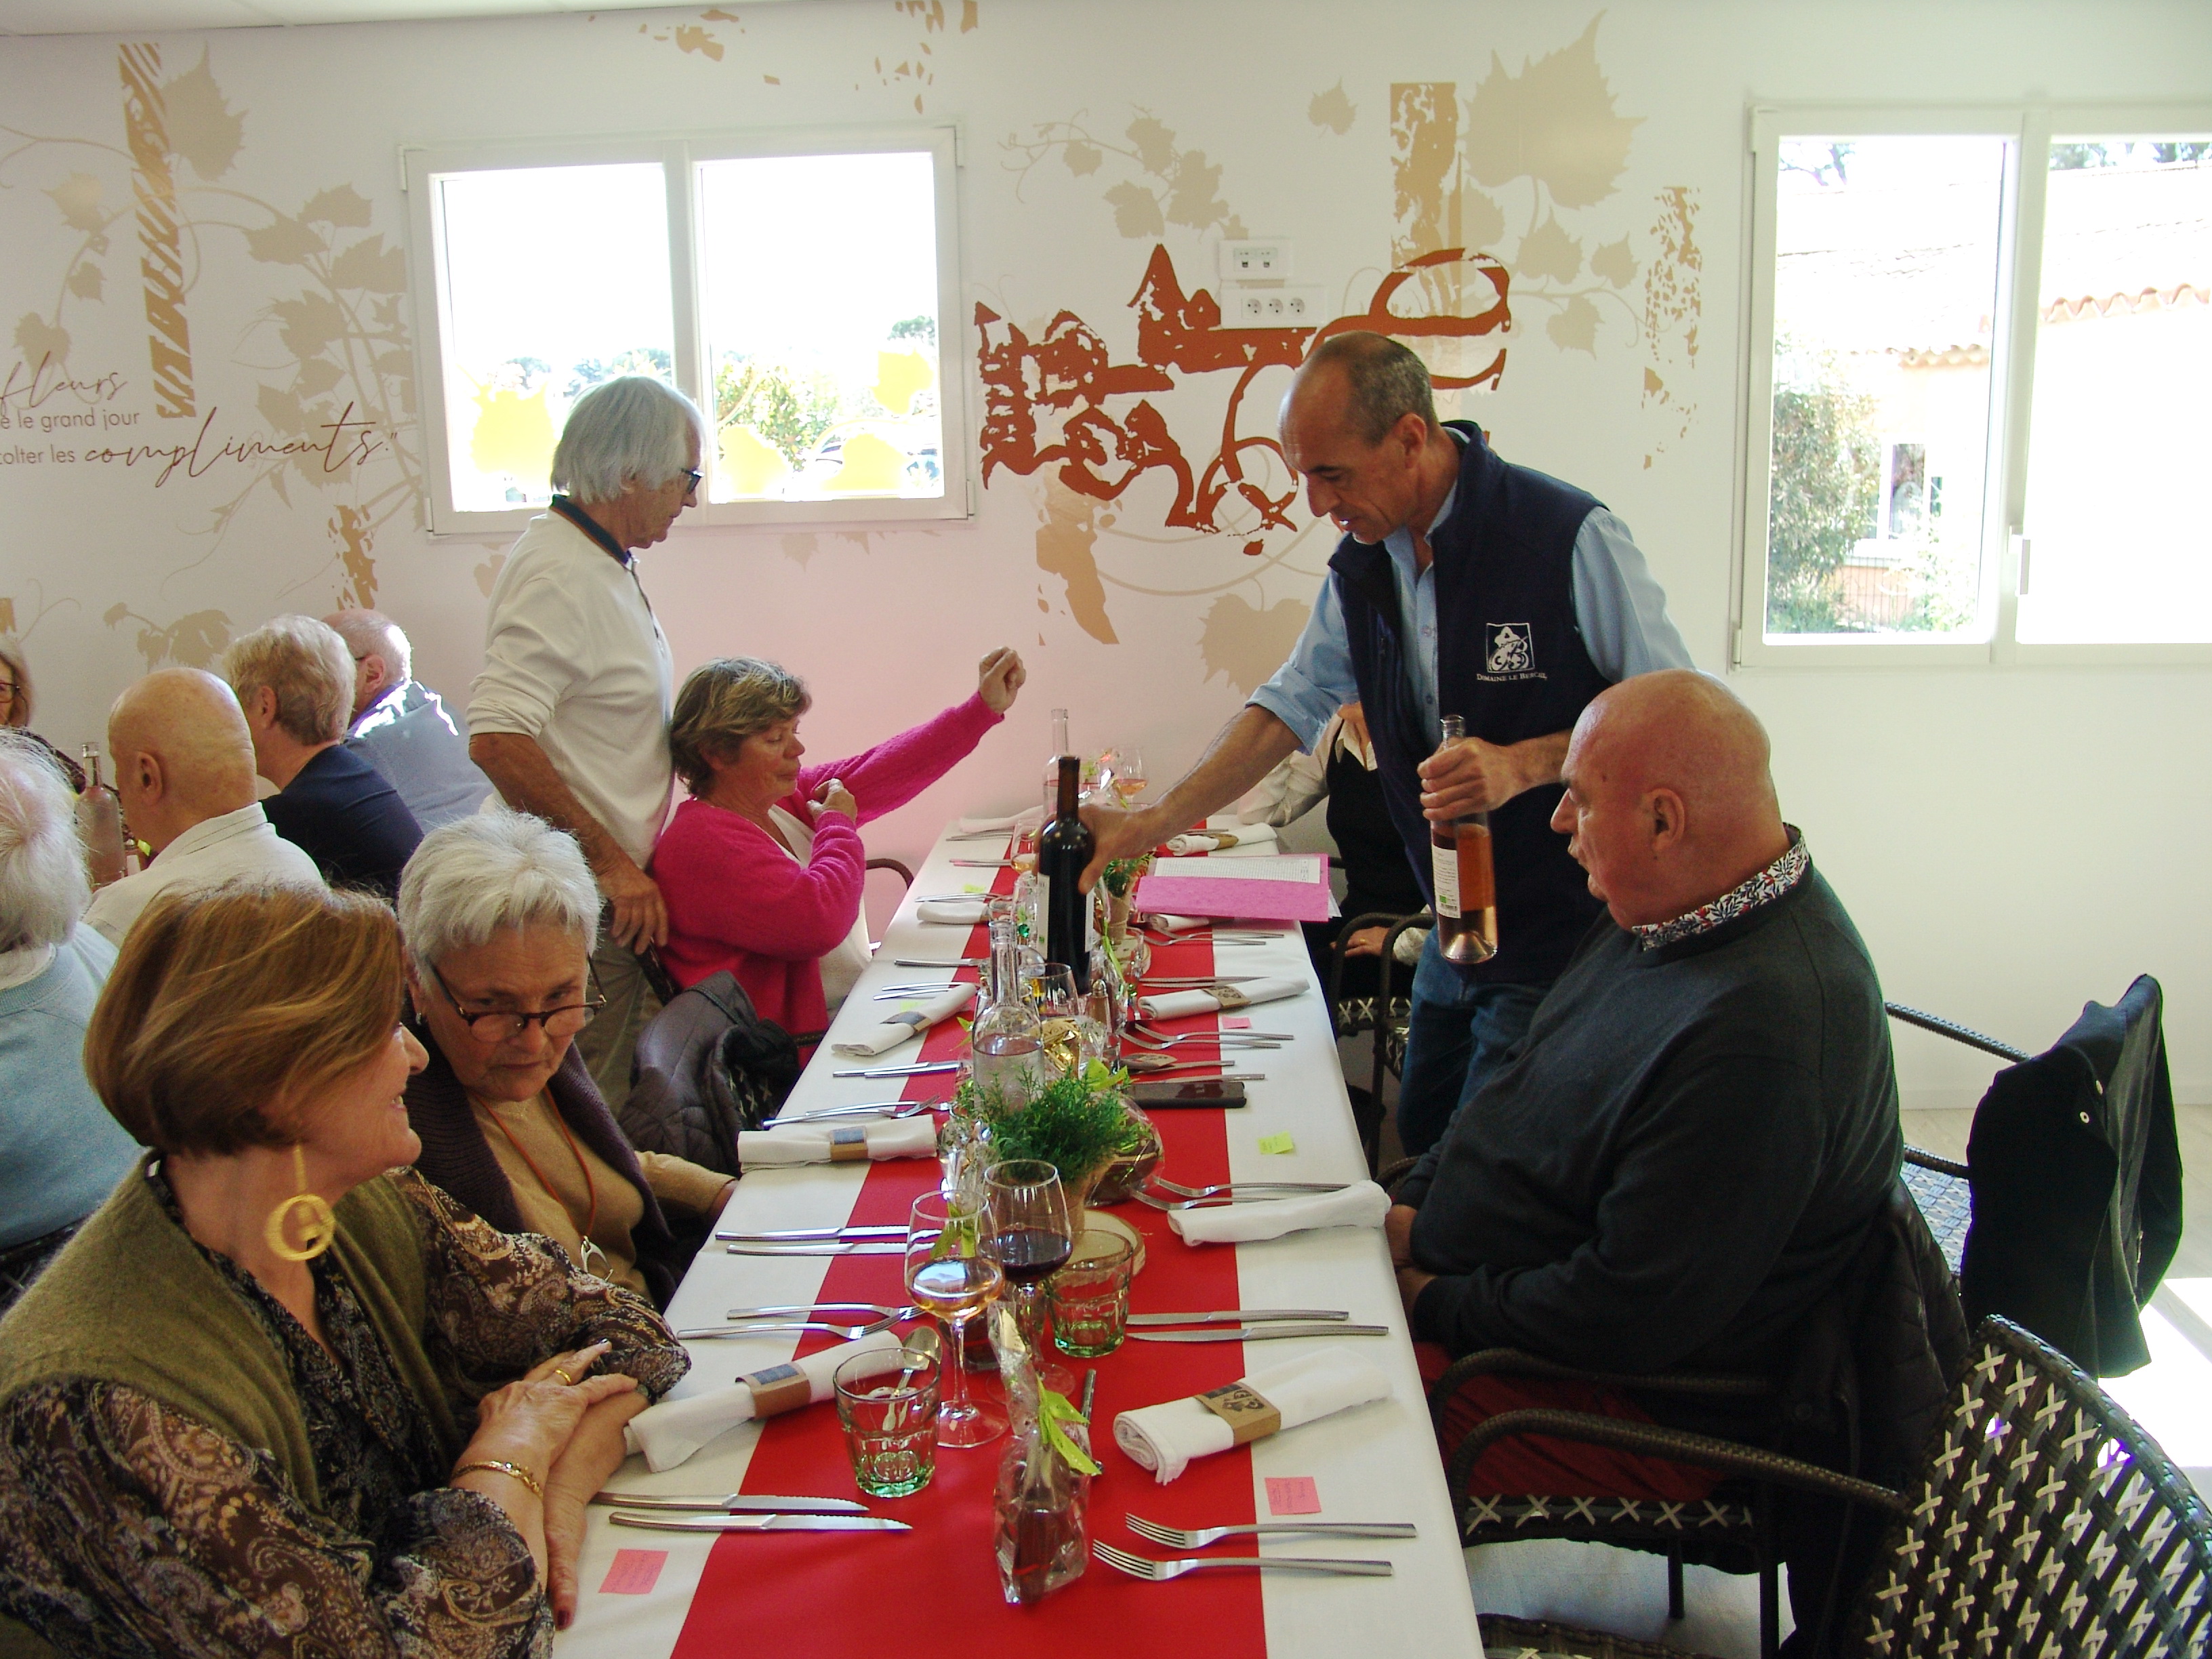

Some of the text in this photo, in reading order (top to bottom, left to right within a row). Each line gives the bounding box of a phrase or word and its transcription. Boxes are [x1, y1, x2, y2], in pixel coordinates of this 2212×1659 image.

[18, 409, 33, 428] le
[41, 407, 95, 432] grand
[103, 408, 140, 430] jour
[50, 443, 75, 463] les
